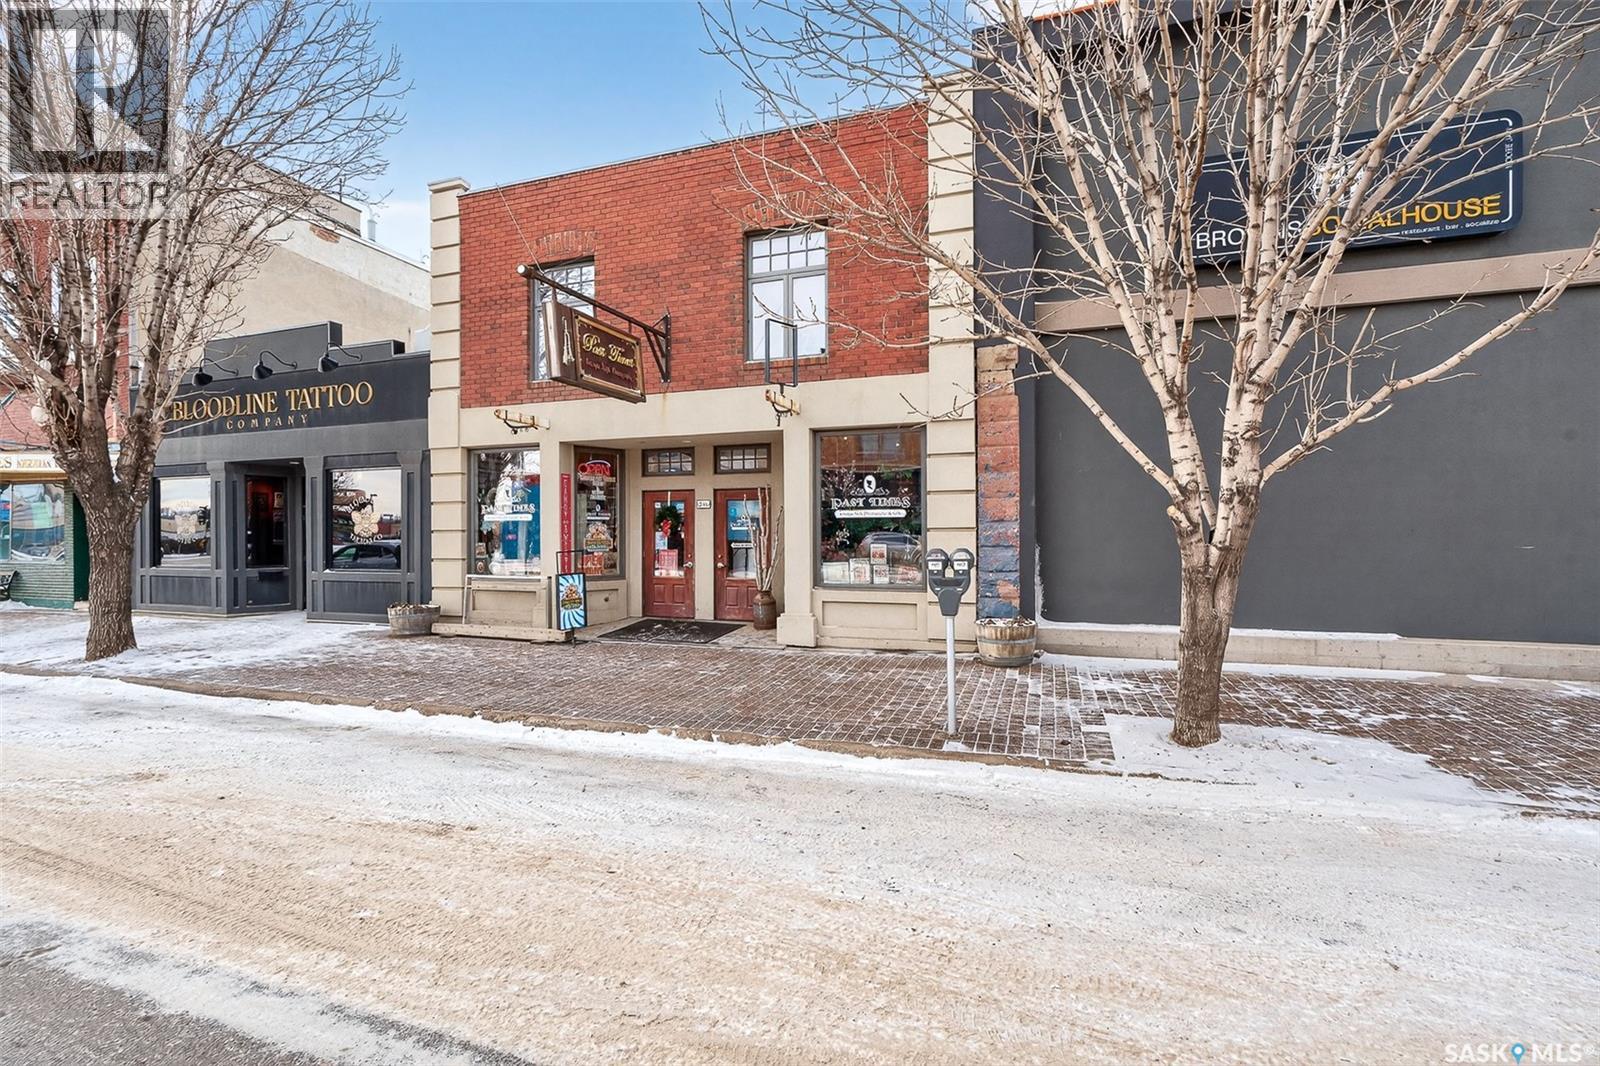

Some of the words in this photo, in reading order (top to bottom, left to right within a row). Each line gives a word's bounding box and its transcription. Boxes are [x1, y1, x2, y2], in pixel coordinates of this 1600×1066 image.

[1196, 220, 1302, 249] BROS
[1311, 193, 1502, 236] OALHOUSE
[1401, 225, 1440, 235] restaurant
[1445, 223, 1459, 231] bar
[172, 391, 279, 421] BLOODLINE
[286, 380, 373, 411] TATTOO
[226, 413, 309, 430] COMPANY
[577, 462, 611, 476] OPEN
[831, 497, 866, 510] PAST
